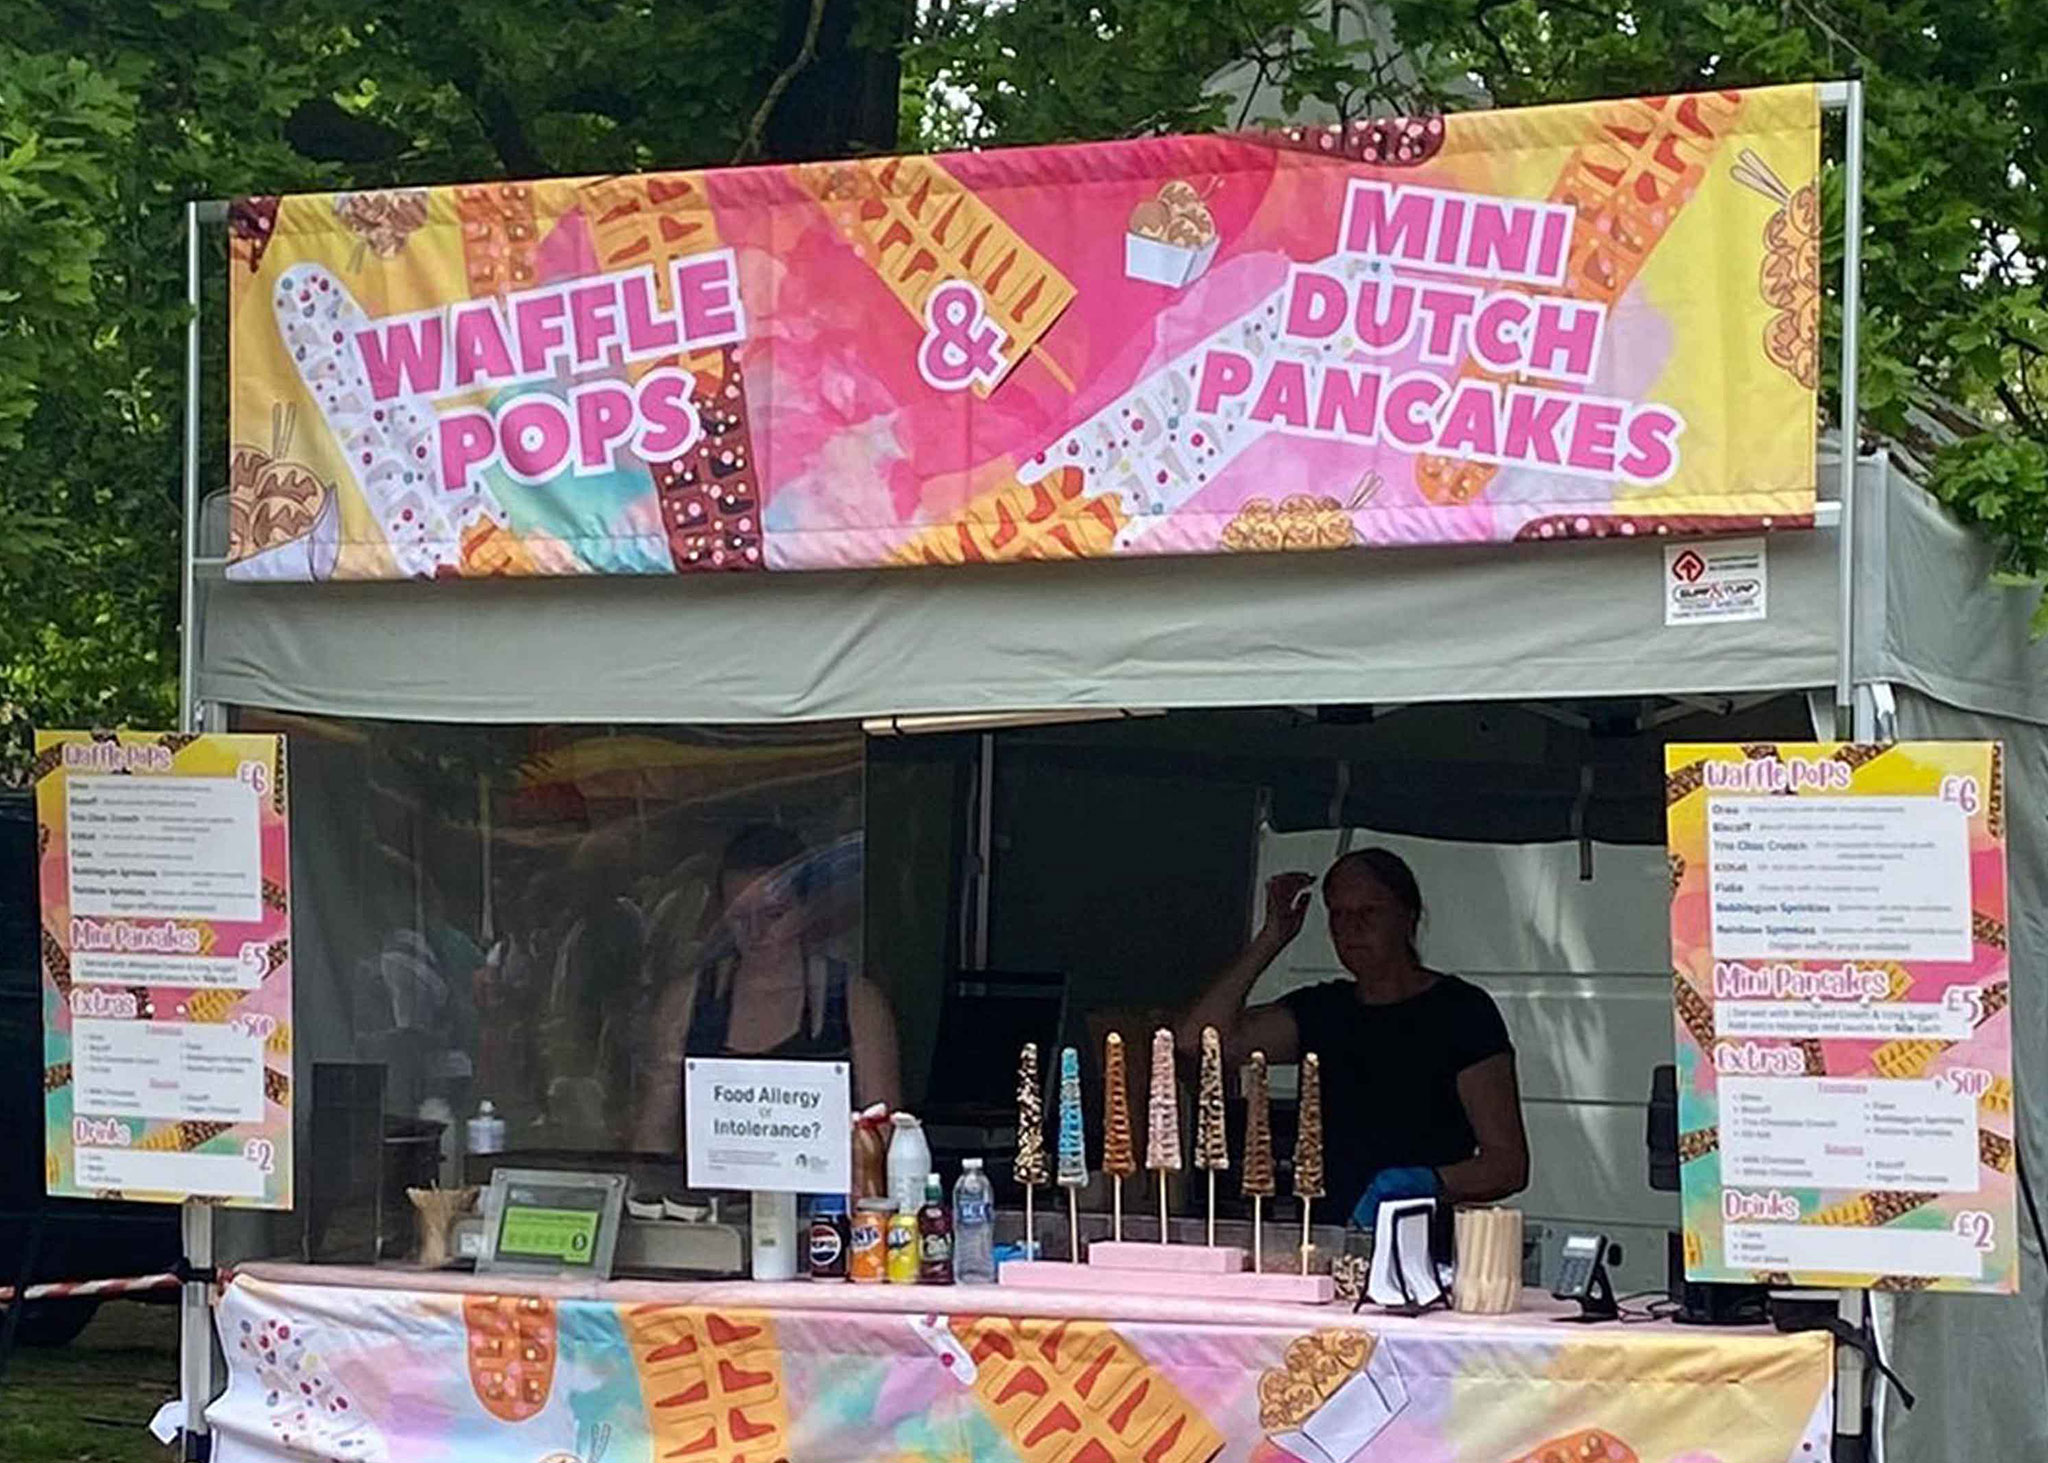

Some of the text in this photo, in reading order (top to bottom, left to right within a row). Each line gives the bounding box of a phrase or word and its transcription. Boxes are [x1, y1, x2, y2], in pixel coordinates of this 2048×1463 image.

[1346, 185, 1568, 280] MINI
[355, 256, 739, 402] WAFFLE
[924, 285, 1004, 384] &
[1286, 273, 1598, 376] DUTCH
[438, 373, 696, 490] POPS
[1196, 356, 1678, 479] PANCAKES
[1706, 760, 1786, 788] Waffle
[1942, 778, 1977, 813] £6
[72, 921, 198, 950] Mini Pancakes
[242, 945, 268, 974] £5
[1716, 964, 1888, 998] Mini Pancakes
[1946, 988, 1980, 1023] £5
[1716, 1044, 1803, 1073] Extras
[714, 1085, 822, 1109] Food Allergy
[75, 1120, 130, 1143] Drinks
[714, 1119, 822, 1139] Intolerance?
[247, 1142, 272, 1171] £2
[1724, 1193, 1799, 1219] Drinks
[1957, 1214, 1992, 1248] £2
